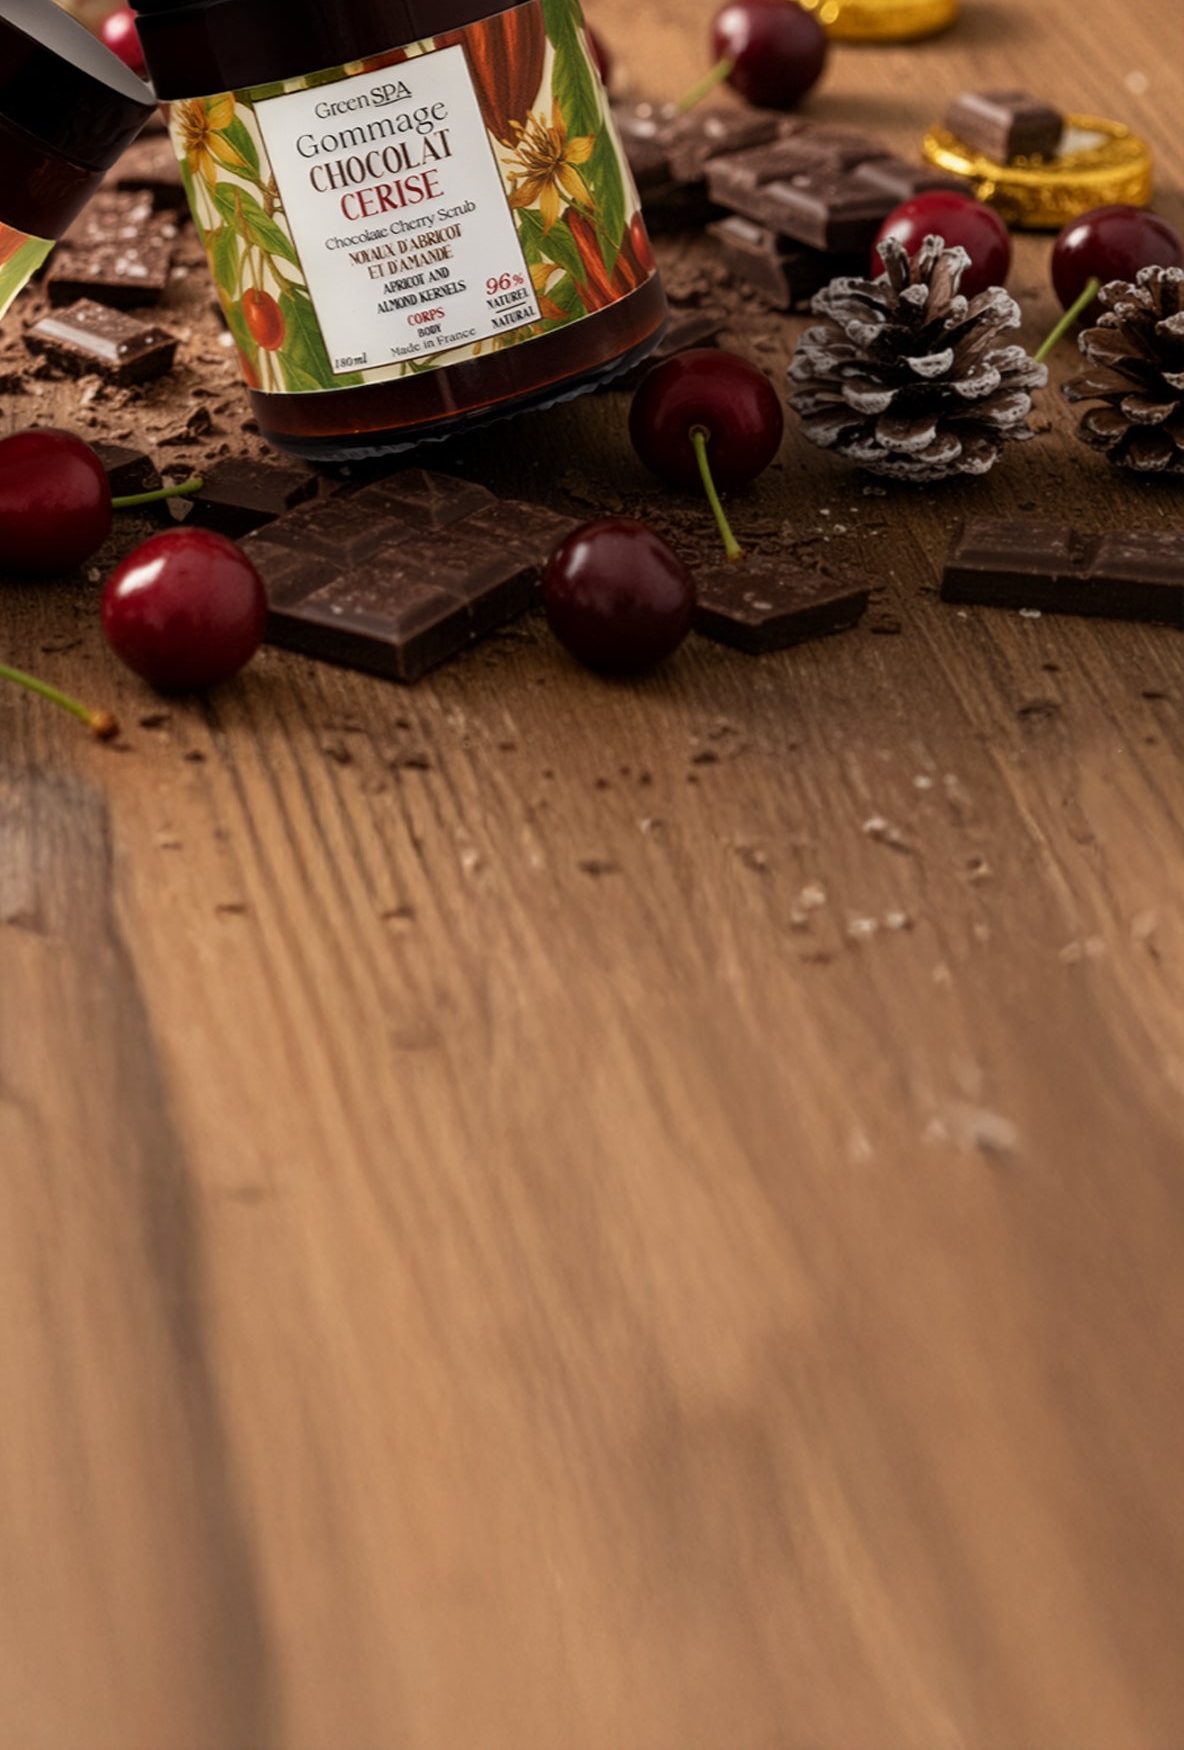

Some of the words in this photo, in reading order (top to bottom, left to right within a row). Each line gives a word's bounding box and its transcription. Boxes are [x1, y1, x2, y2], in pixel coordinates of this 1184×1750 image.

[296, 101, 449, 159] Gommage
[309, 128, 453, 193] CHOCOLAT
[340, 168, 445, 221] CERISE
[324, 227, 390, 251] Chocolate
[388, 213, 436, 235] Cherry
[436, 199, 477, 222] Scrub
[348, 242, 397, 265] NOYAUX
[367, 263, 385, 280] ET
[383, 272, 426, 295] APRICOT
[428, 266, 451, 283] AND
[377, 293, 419, 314] ALMOND
[418, 279, 467, 304] KERNELS
[485, 287, 530, 310] NATUREL
[407, 306, 446, 327] CORPS
[417, 323, 442, 338] BODY
[490, 306, 537, 329] NATURAL
[389, 342, 422, 358] Made
[422, 339, 436, 350] in
[435, 327, 477, 346] France
